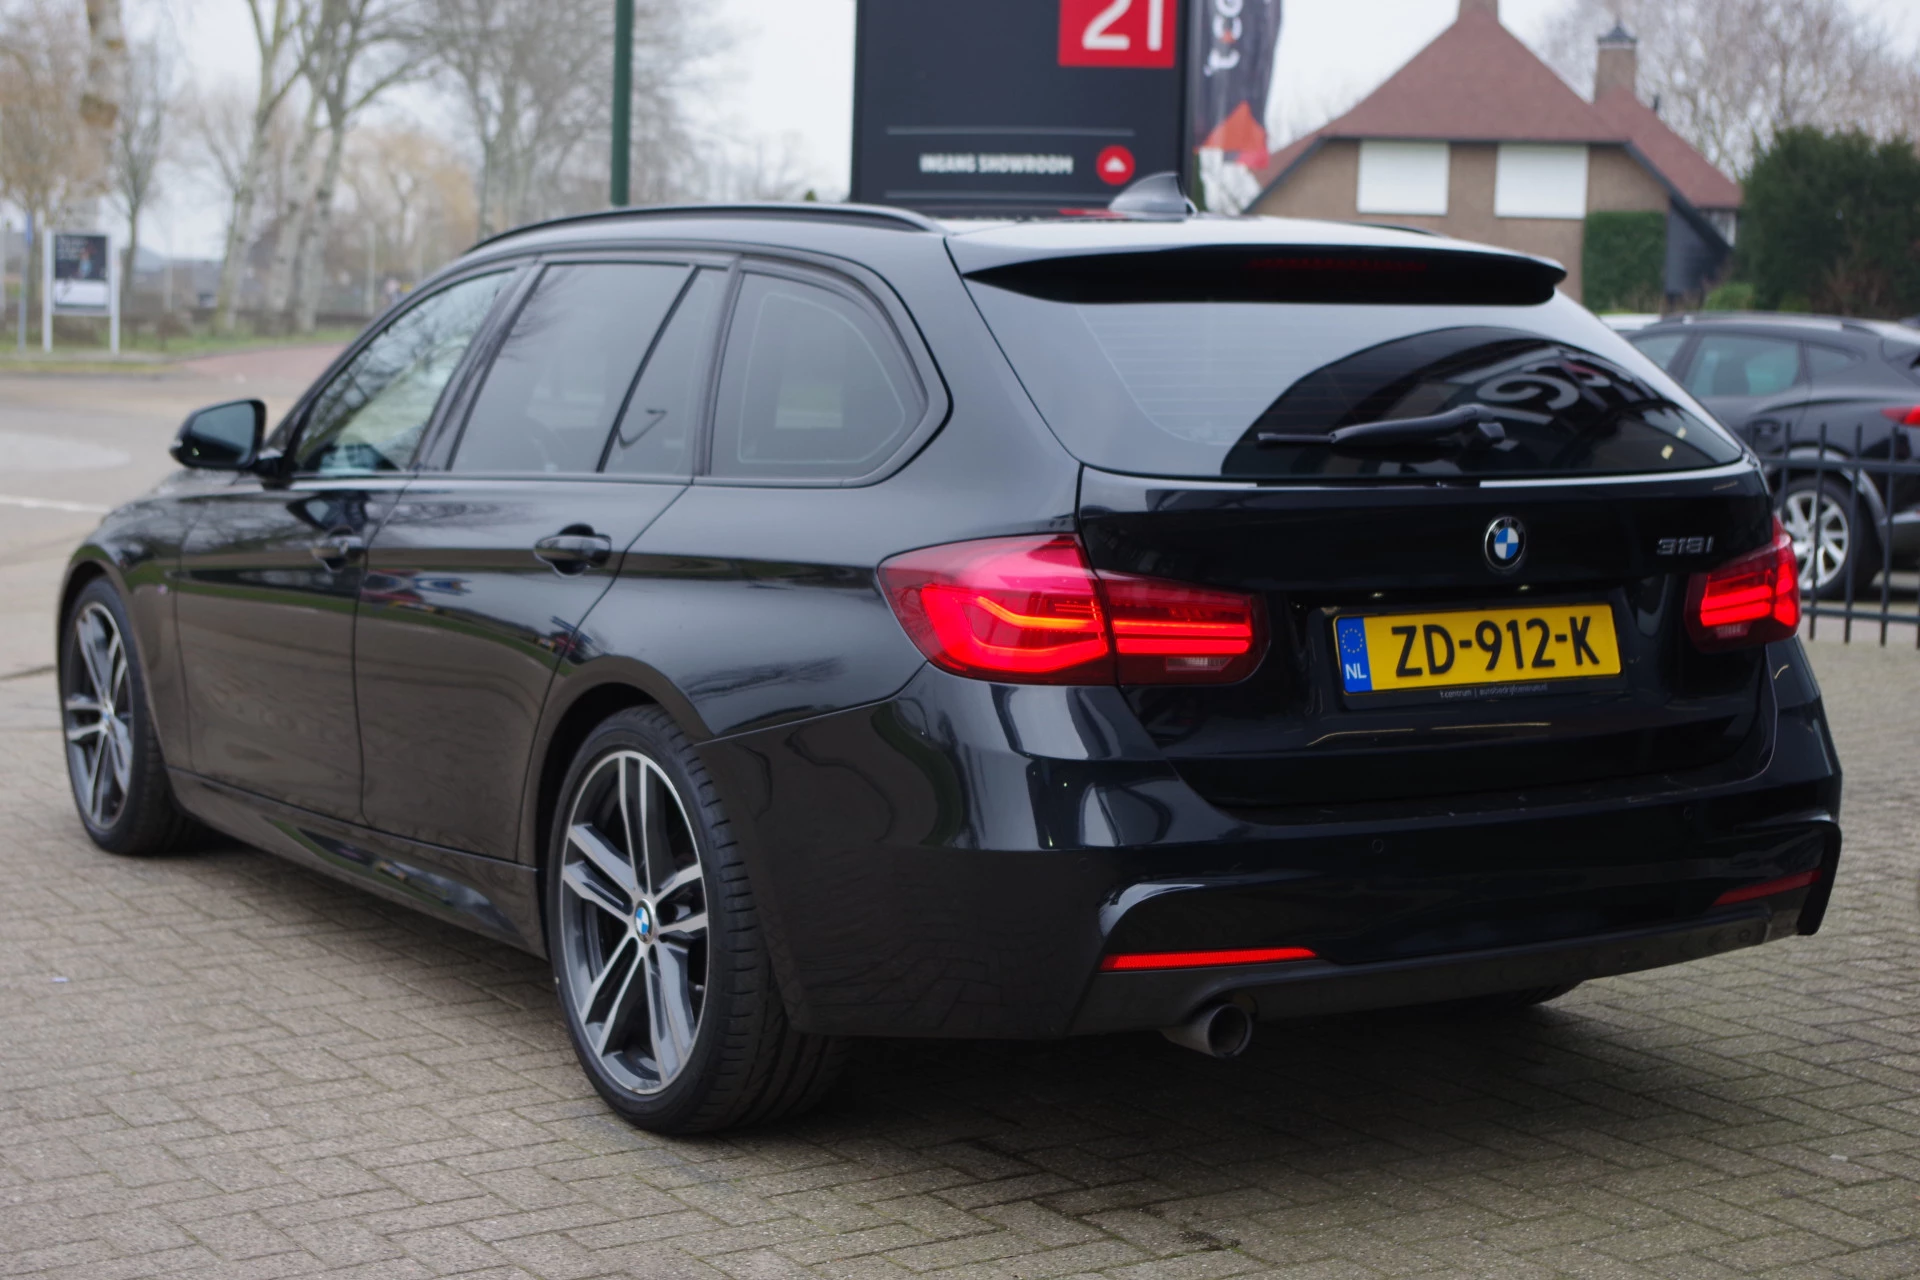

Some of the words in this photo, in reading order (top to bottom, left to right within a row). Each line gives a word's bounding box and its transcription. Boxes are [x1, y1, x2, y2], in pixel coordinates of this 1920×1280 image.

[978, 154, 1074, 174] SHOWROOM
[1391, 616, 1600, 678] ZD-912-K
[1345, 663, 1367, 680] NL
